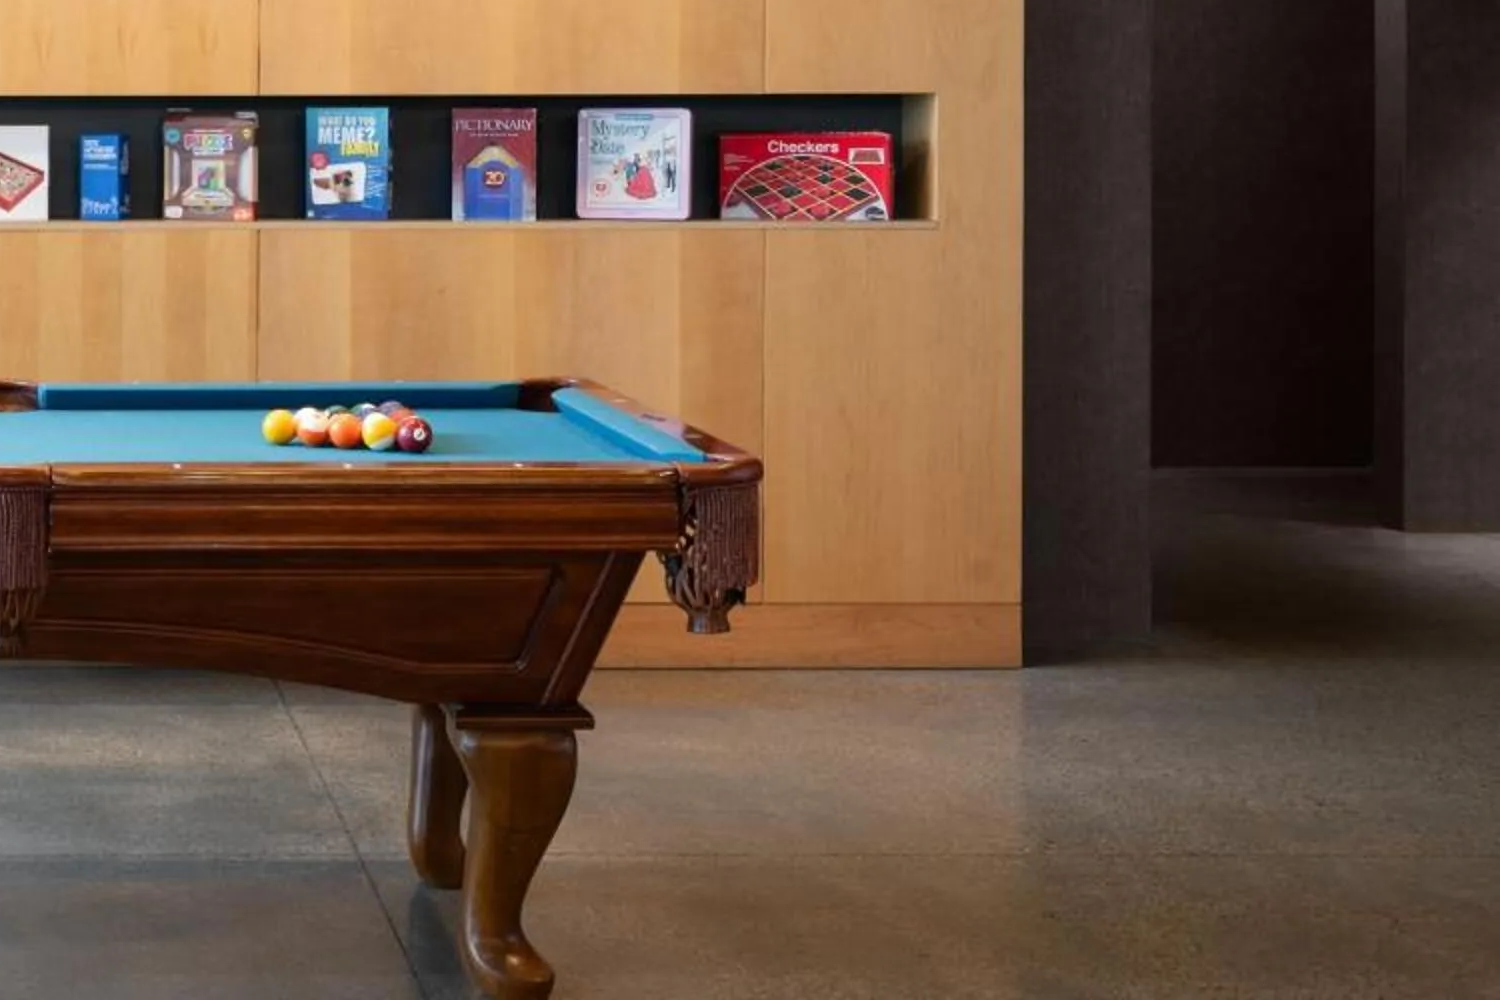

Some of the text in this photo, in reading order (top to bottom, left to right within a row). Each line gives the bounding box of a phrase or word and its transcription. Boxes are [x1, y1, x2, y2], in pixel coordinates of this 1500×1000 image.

[456, 120, 532, 131] PICTIONARY
[318, 127, 376, 144] MEME?
[767, 139, 840, 153] Checkers
[484, 171, 506, 185] 20
